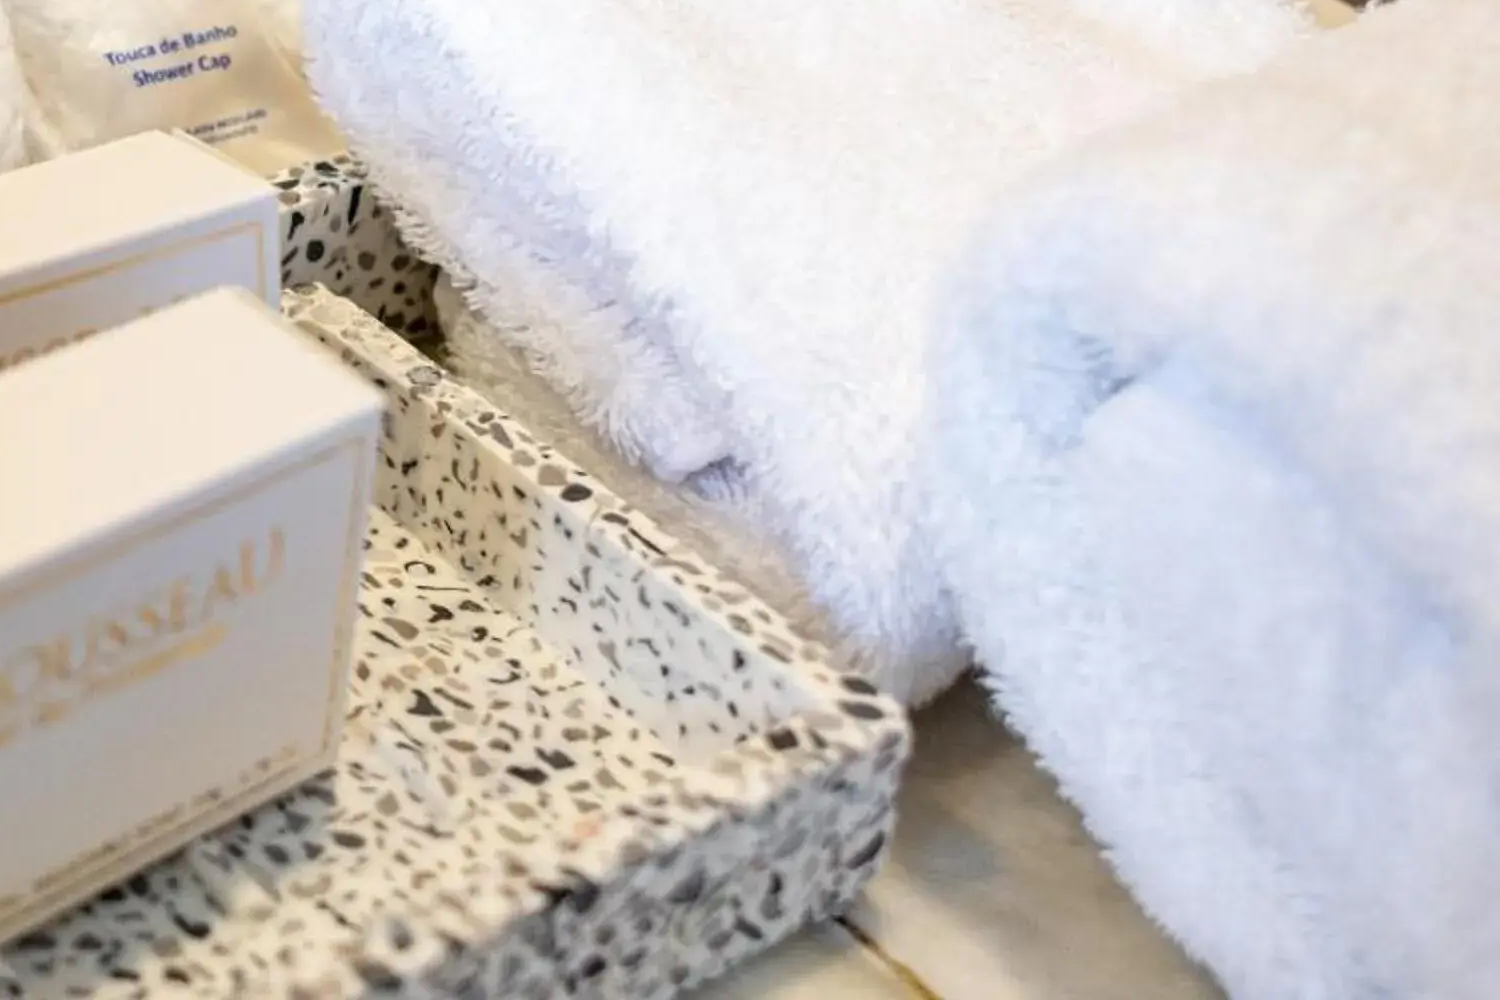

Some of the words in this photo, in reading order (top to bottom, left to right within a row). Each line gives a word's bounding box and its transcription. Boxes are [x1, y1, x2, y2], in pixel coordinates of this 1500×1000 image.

[103, 44, 156, 66] Touca
[159, 38, 180, 54] de
[182, 25, 238, 49] Banho
[132, 61, 194, 88] Shower
[197, 53, 232, 71] Cap
